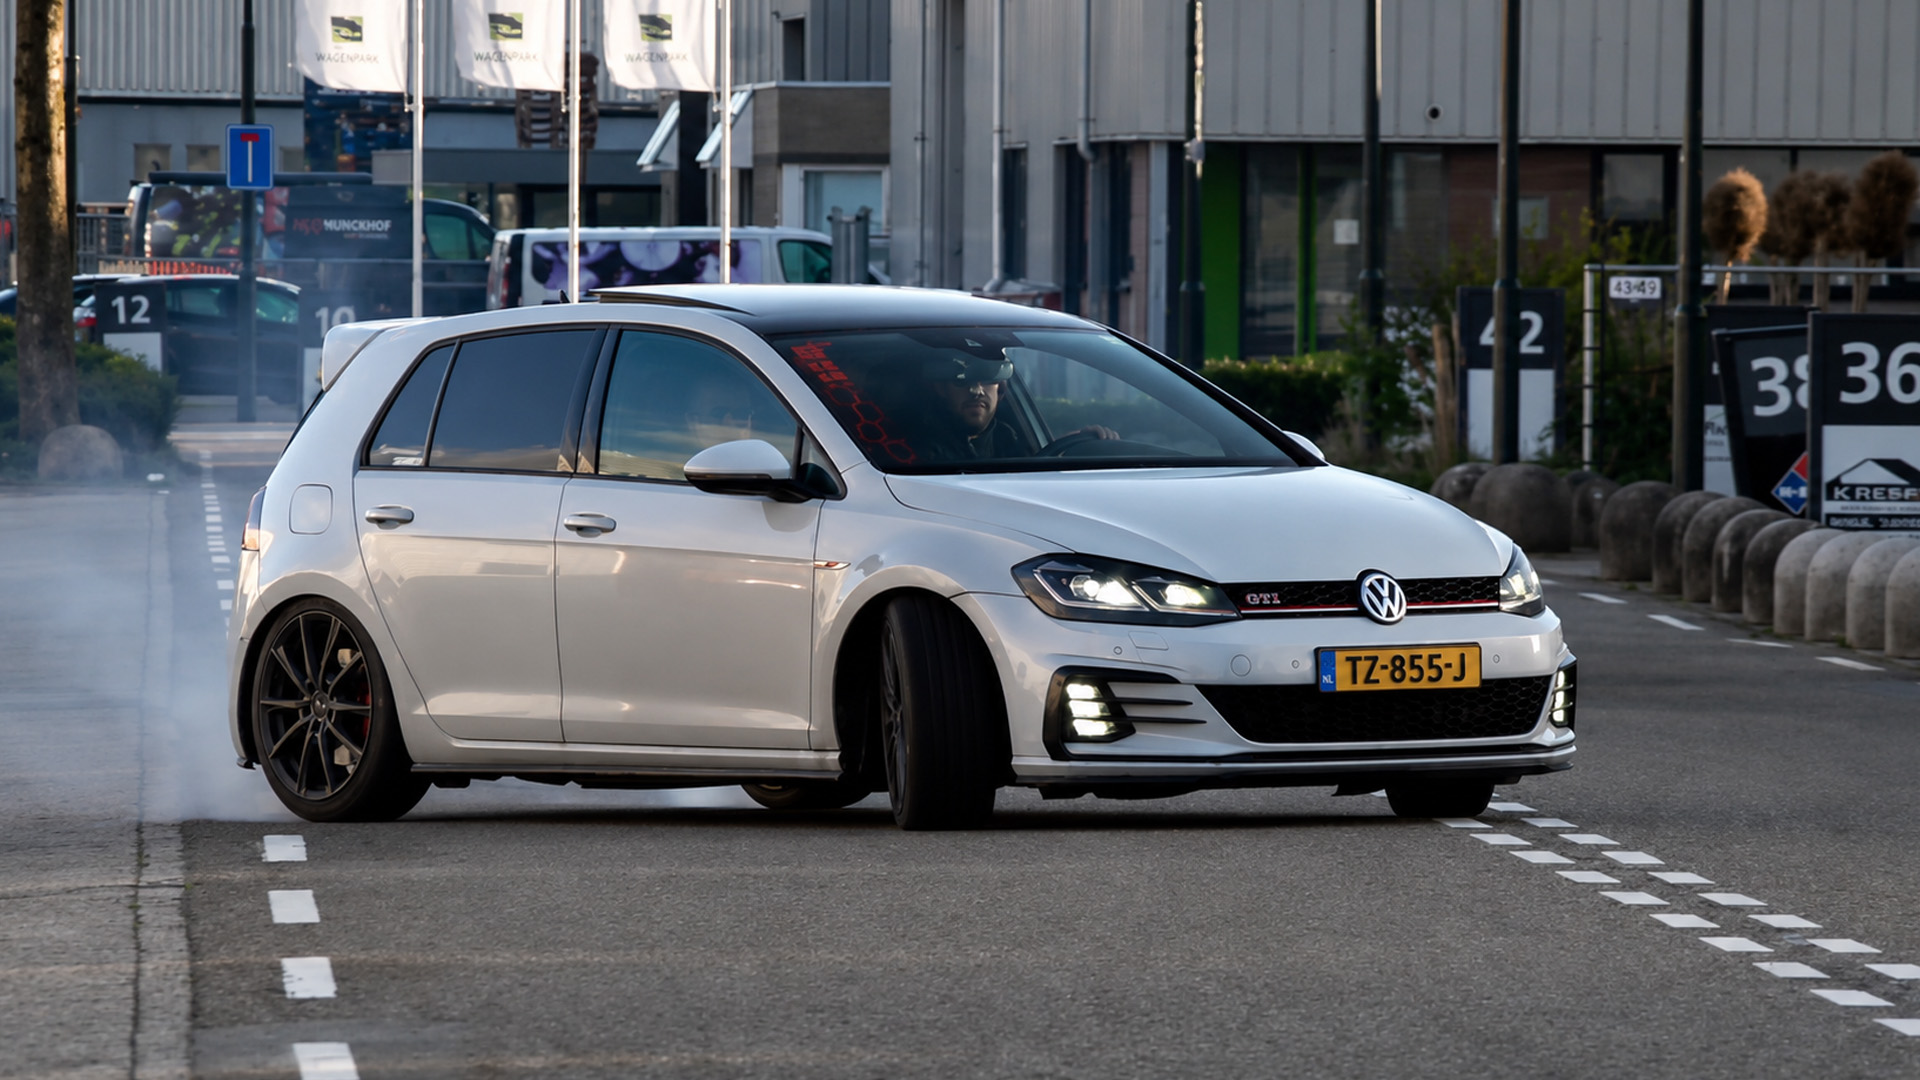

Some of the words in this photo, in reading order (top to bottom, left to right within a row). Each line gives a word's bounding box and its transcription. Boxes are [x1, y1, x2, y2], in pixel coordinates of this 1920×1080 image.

[315, 52, 380, 64] WAGENPARK
[473, 51, 539, 62] WAGENPARK
[624, 51, 688, 63] WAGENPARK
[323, 218, 392, 232] MUNCKHOF
[111, 294, 151, 325] 12
[1839, 341, 1920, 404] 36
[1245, 592, 1281, 605] GTI
[1345, 652, 1466, 685] TZ-855-J
[1322, 674, 1334, 684] NL
